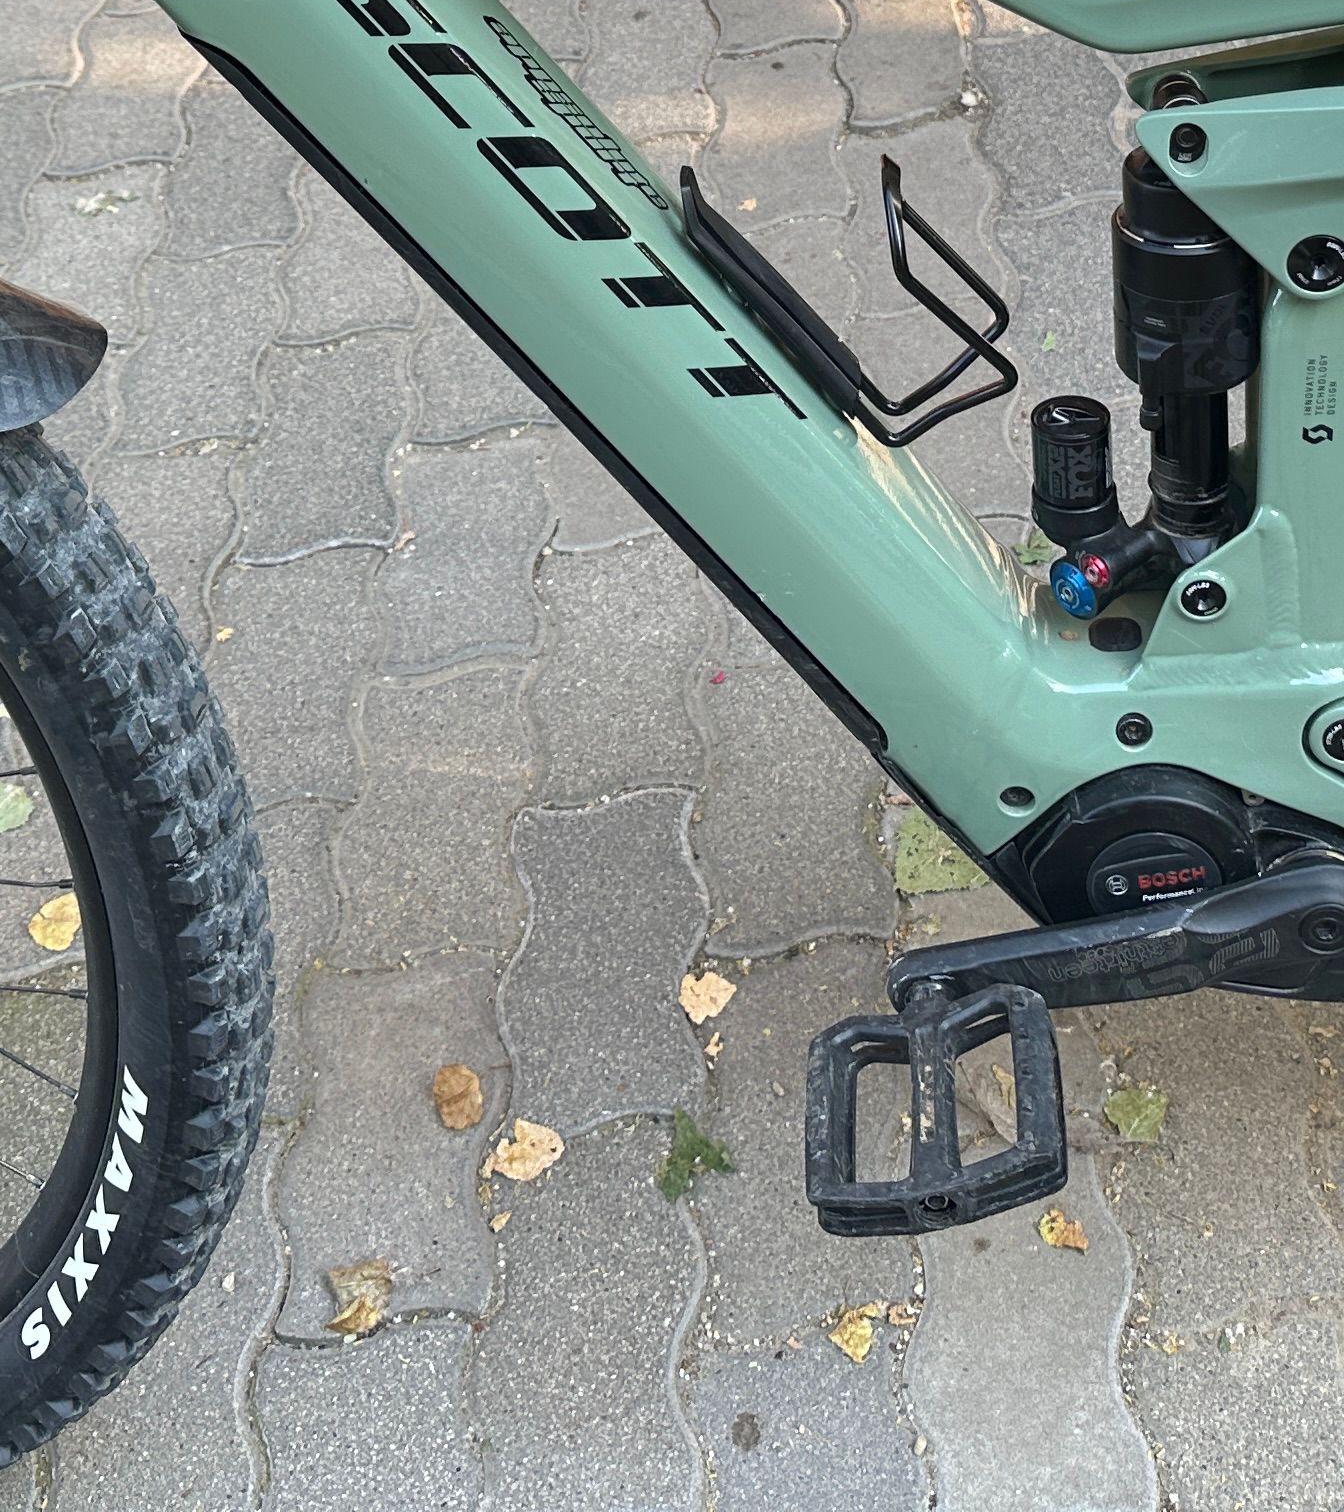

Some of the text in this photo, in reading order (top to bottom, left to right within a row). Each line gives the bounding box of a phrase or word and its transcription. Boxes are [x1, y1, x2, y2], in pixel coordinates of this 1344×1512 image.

[1304, 358, 1317, 416] INNOVATION
[1315, 354, 1329, 416] TECHNOLOGY
[1326, 380, 1338, 416] DESIGN
[1138, 865, 1206, 889] BOSCH
[20, 1065, 149, 1361] MAXXIS
